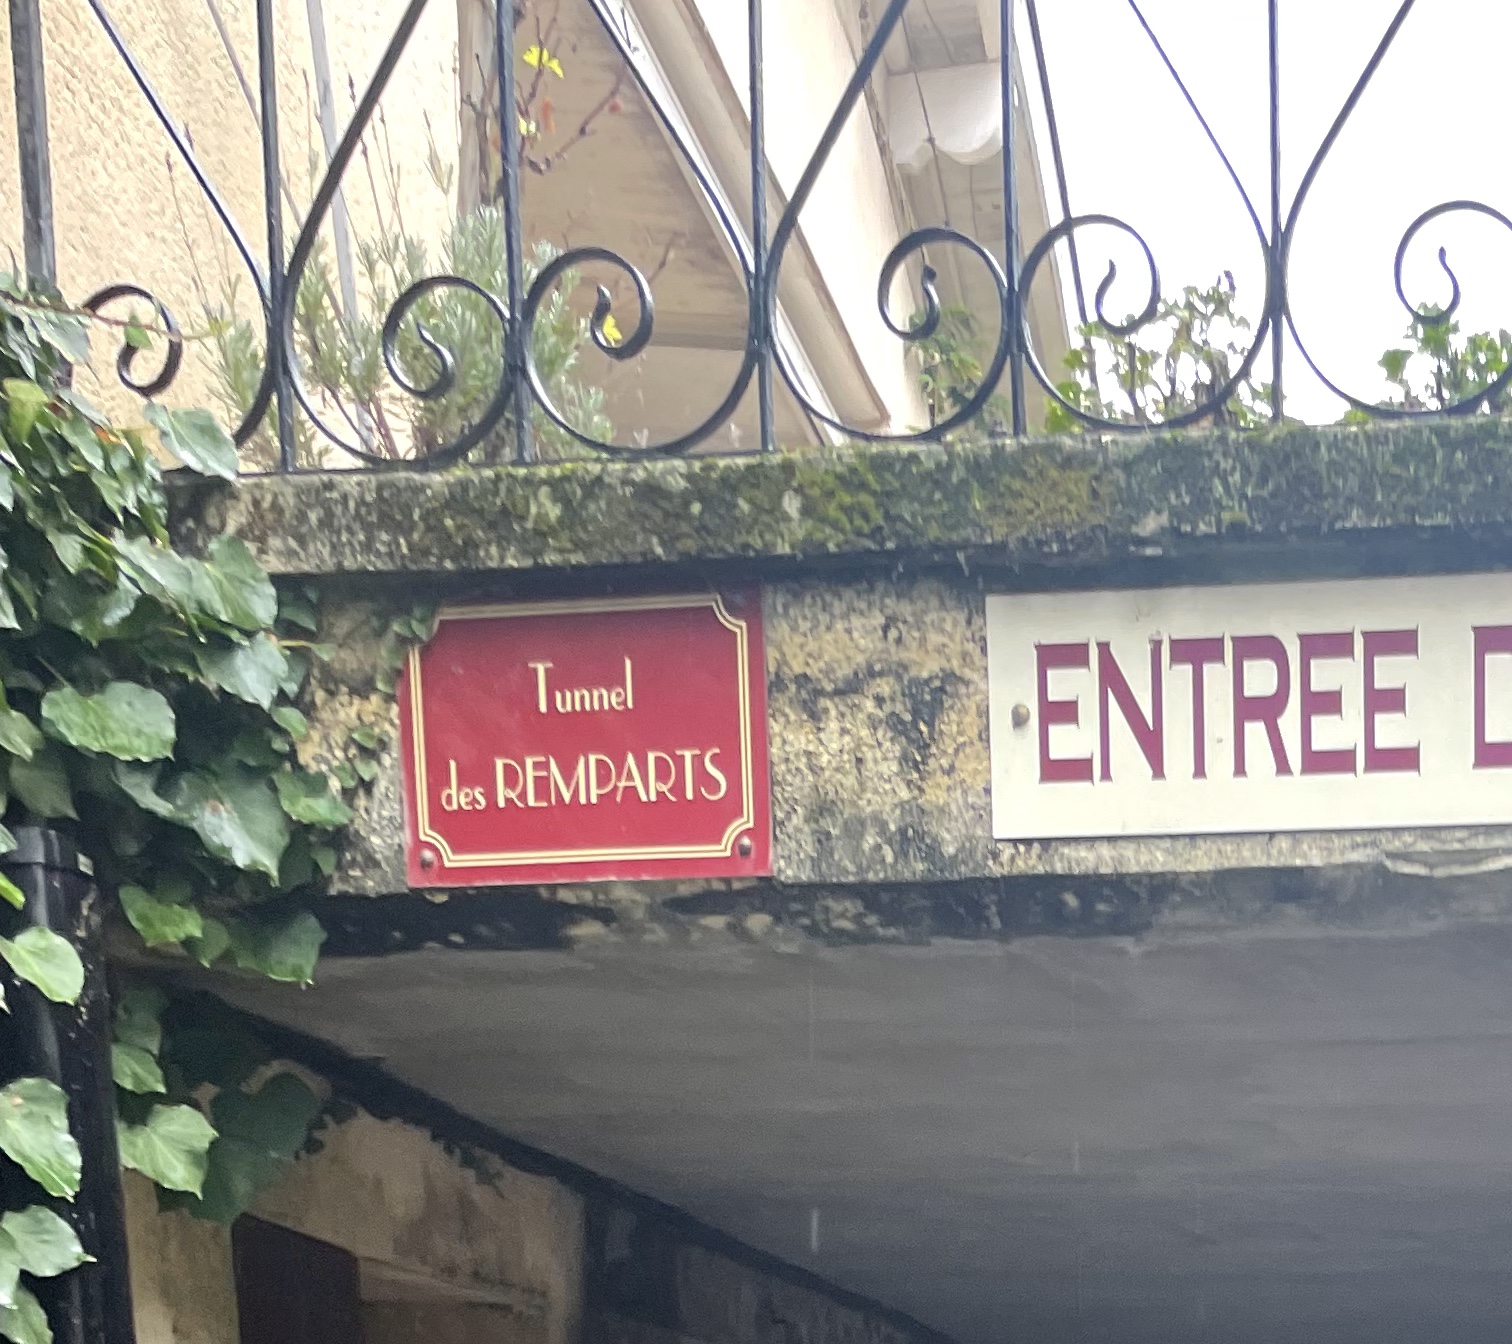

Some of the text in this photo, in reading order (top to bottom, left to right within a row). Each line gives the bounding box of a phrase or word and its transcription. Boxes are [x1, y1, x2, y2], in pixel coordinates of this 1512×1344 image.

[528, 656, 634, 713] Tunnel
[1033, 626, 1420, 784] ENTREE
[440, 747, 727, 812] des REMPARTS
